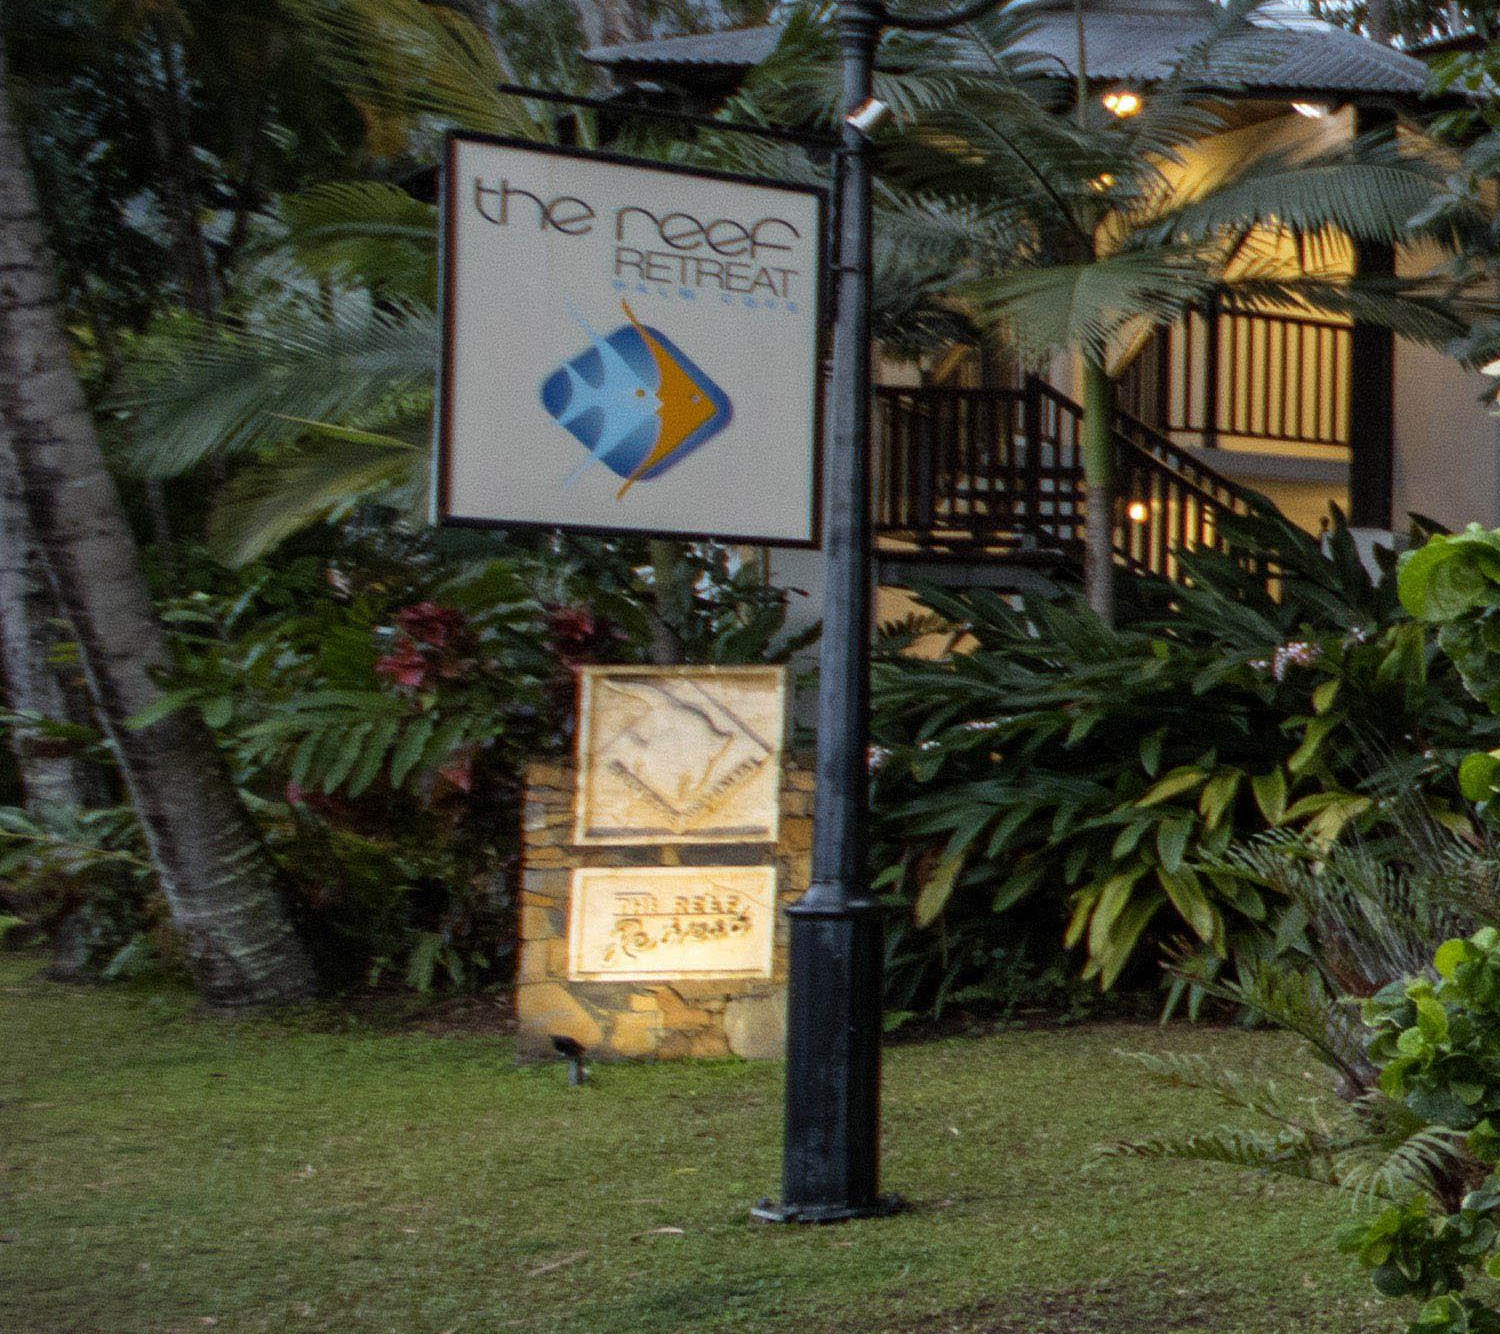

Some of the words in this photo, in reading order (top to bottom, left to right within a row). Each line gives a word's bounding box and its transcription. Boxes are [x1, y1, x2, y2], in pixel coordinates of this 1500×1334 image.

[474, 177, 597, 236] the
[614, 206, 801, 259] reef
[613, 247, 800, 299] RETREAT
